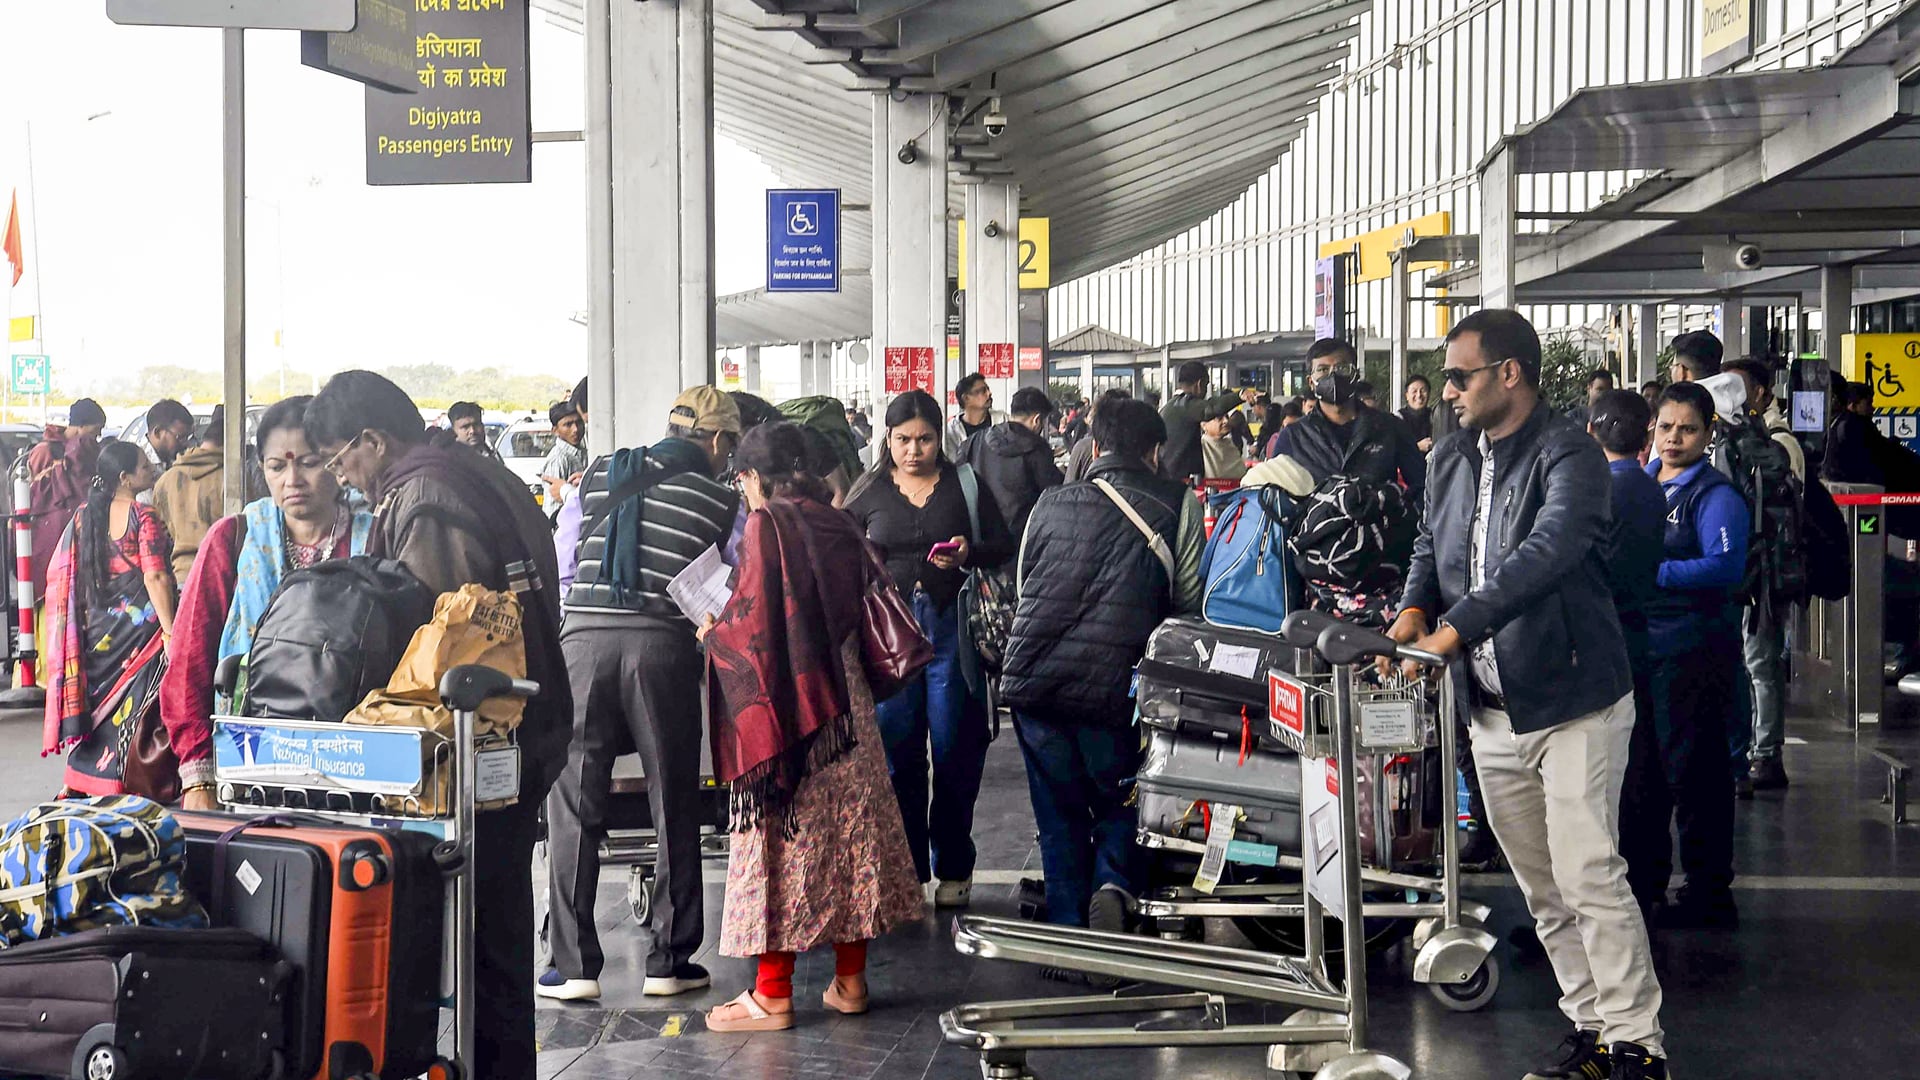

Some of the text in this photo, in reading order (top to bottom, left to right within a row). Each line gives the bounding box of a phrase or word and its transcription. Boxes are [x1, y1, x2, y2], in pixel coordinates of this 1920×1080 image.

[1703, 0, 1743, 37] Domestic
[443, 67, 464, 87] का
[468, 61, 507, 88] प्रवेश
[408, 107, 481, 130] Digiyatra
[378, 134, 513, 157] Passengers Entry
[1018, 239, 1037, 274] 2
[315, 756, 365, 776] Insurance
